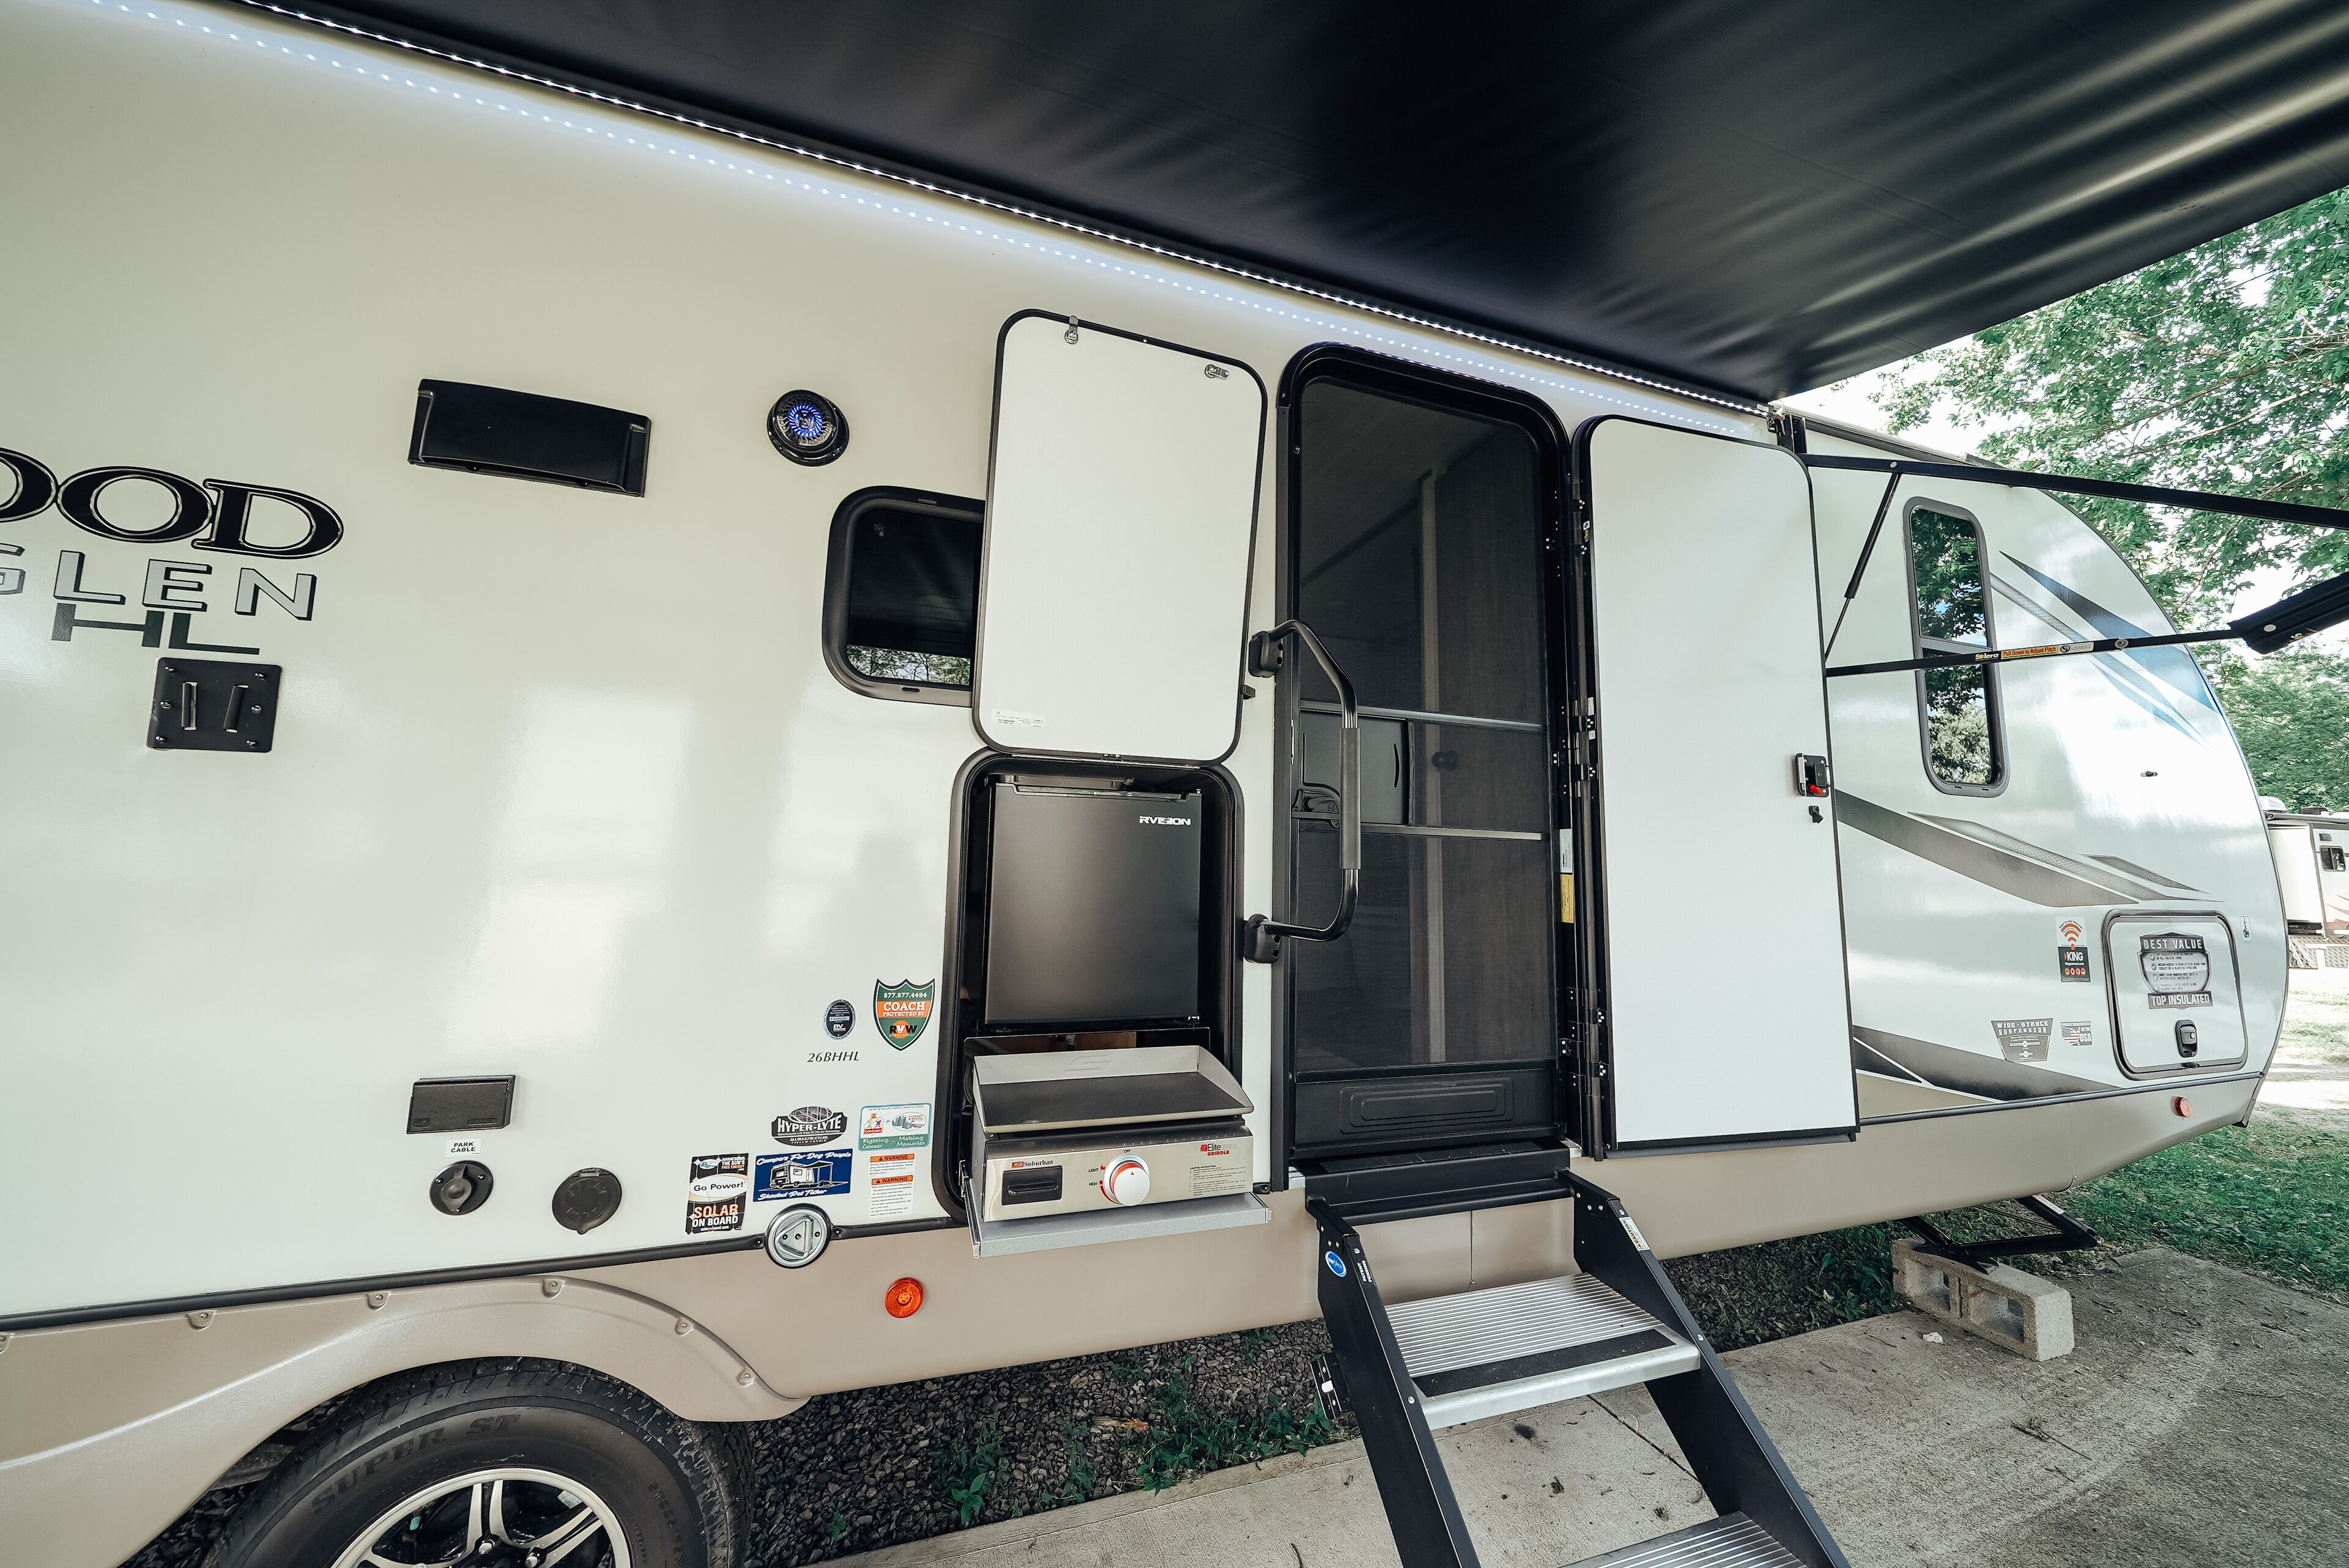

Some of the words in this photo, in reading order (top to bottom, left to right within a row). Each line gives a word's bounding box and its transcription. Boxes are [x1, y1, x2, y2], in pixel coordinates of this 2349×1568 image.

[51, 602, 260, 655] HL
[2143, 939, 2168, 950] BEST
[2172, 939, 2202, 949] VALUE
[2066, 951, 2084, 961] KING
[2151, 995, 2167, 1006] TOP
[2168, 994, 2210, 1005] INSULATED
[883, 1001, 926, 1011] COACH
[889, 1025, 918, 1034] RVW
[2080, 1033, 2091, 1042] USA
[807, 1051, 859, 1063] 26BHHL
[777, 1114, 842, 1133] HYPER-LYTE
[756, 1156, 789, 1165] Campers
[710, 1182, 743, 1190] Power!
[694, 1204, 739, 1219] SOLAR
[692, 1218, 705, 1227] ON
[707, 1216, 738, 1226] BOARD
[1357, 1262, 1367, 1282] PATENT
[1362, 1260, 1373, 1282] PENDING
[312, 1427, 446, 1512] SUPER
[466, 1413, 521, 1435] ST
